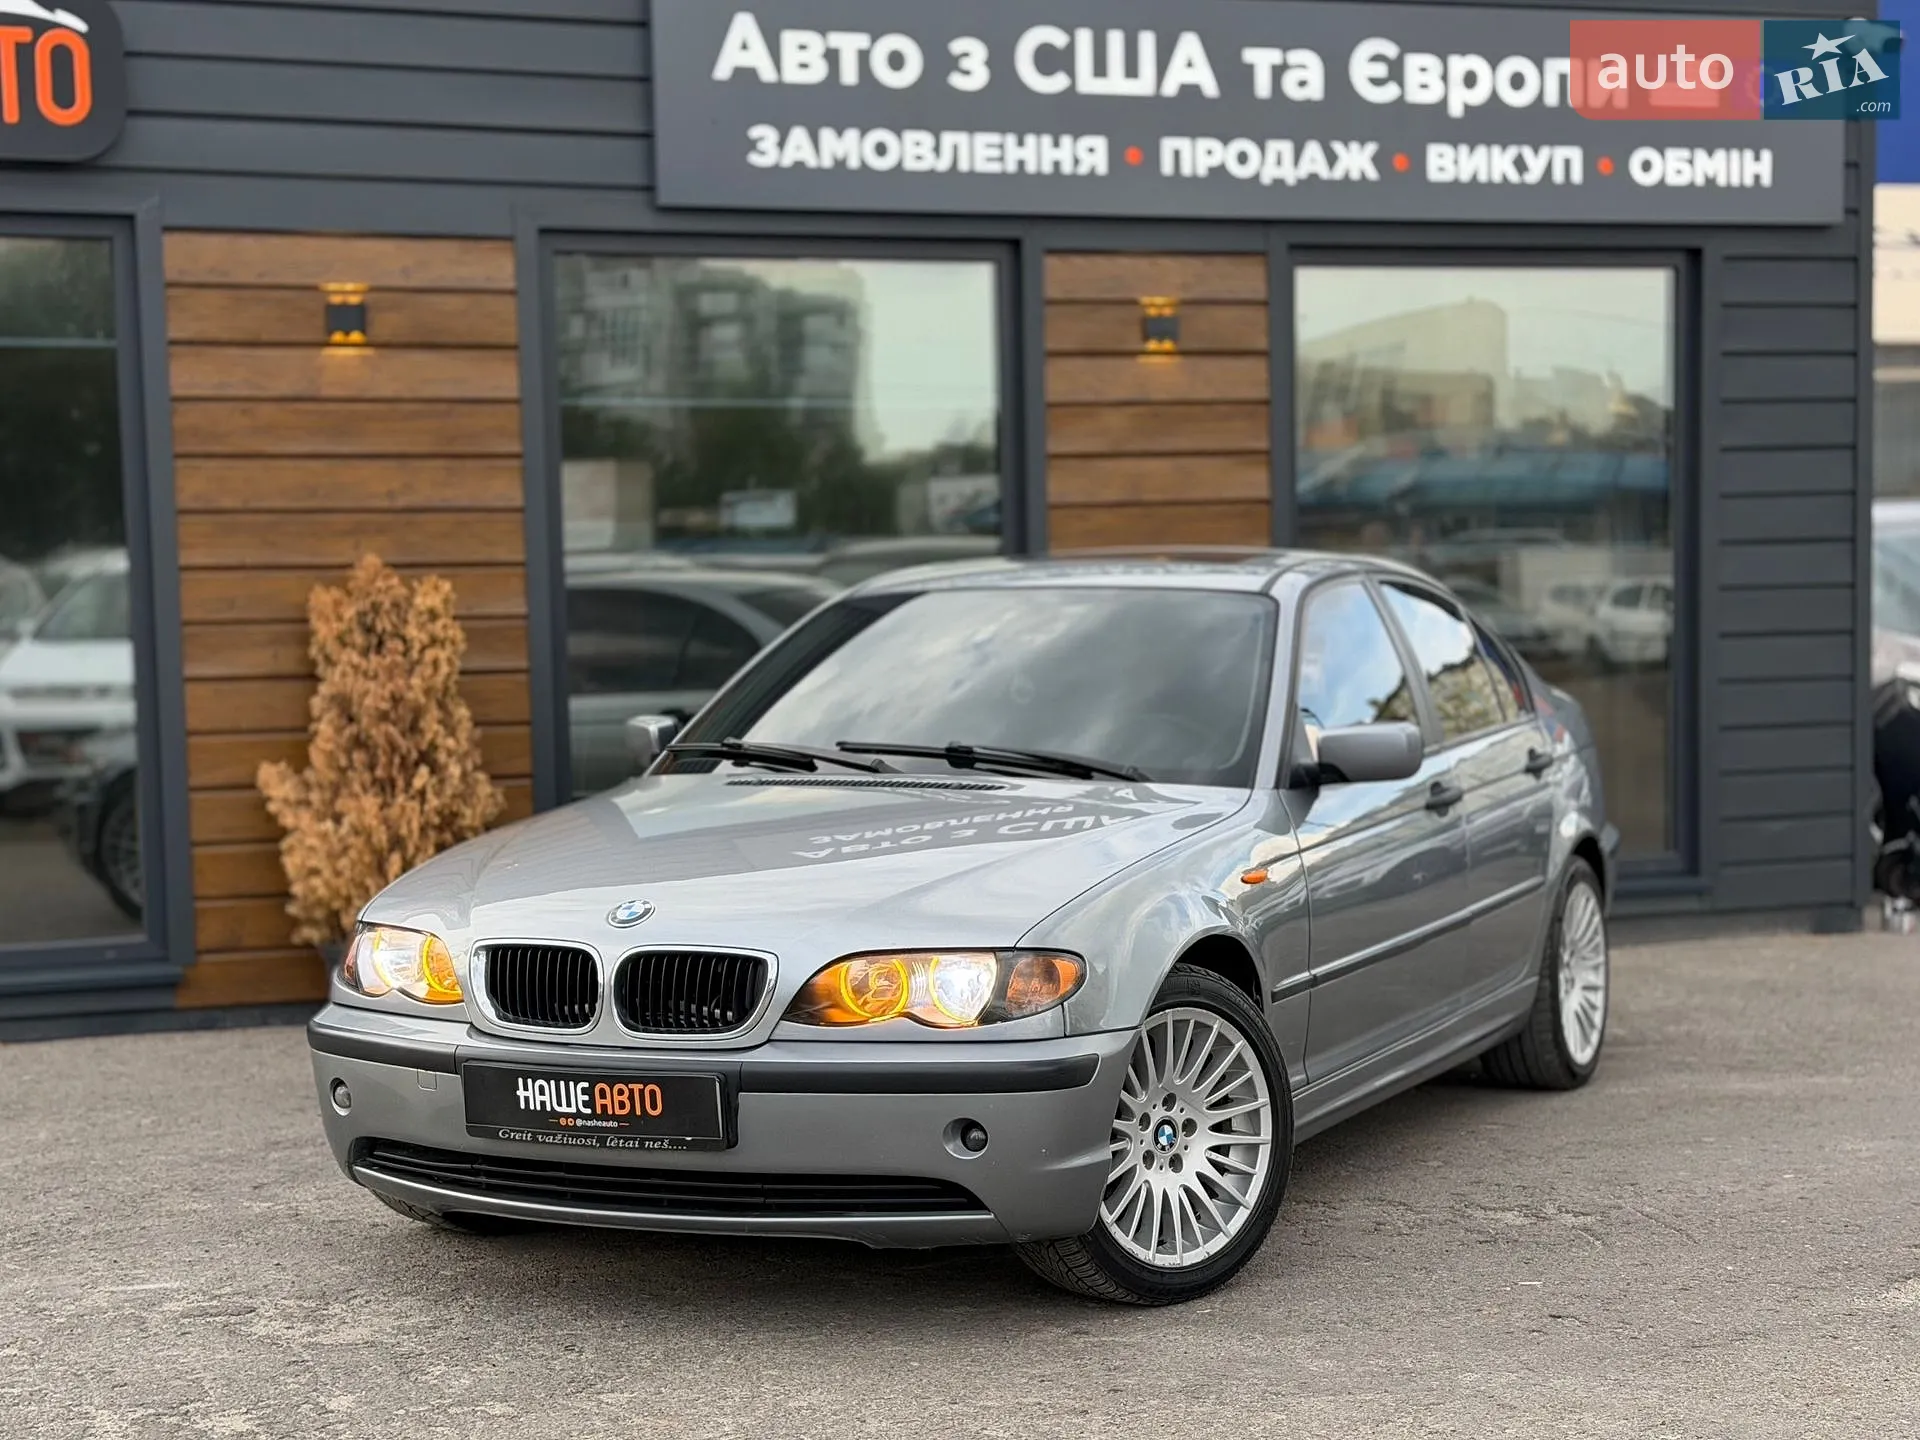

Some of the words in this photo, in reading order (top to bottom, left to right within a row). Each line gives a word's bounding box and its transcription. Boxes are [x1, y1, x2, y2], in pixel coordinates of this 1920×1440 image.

[711, 11, 924, 90] Авто
[1014, 25, 1220, 98] США
[1241, 46, 1325, 101] та
[746, 124, 1109, 176] ЗАМОВЛЕННЯ
[1159, 136, 1380, 186] ПРОДАЖ
[1426, 143, 1584, 184] ВИКУП
[1629, 147, 1773, 188] ОБМІН
[498, 1128, 533, 1141] Greit
